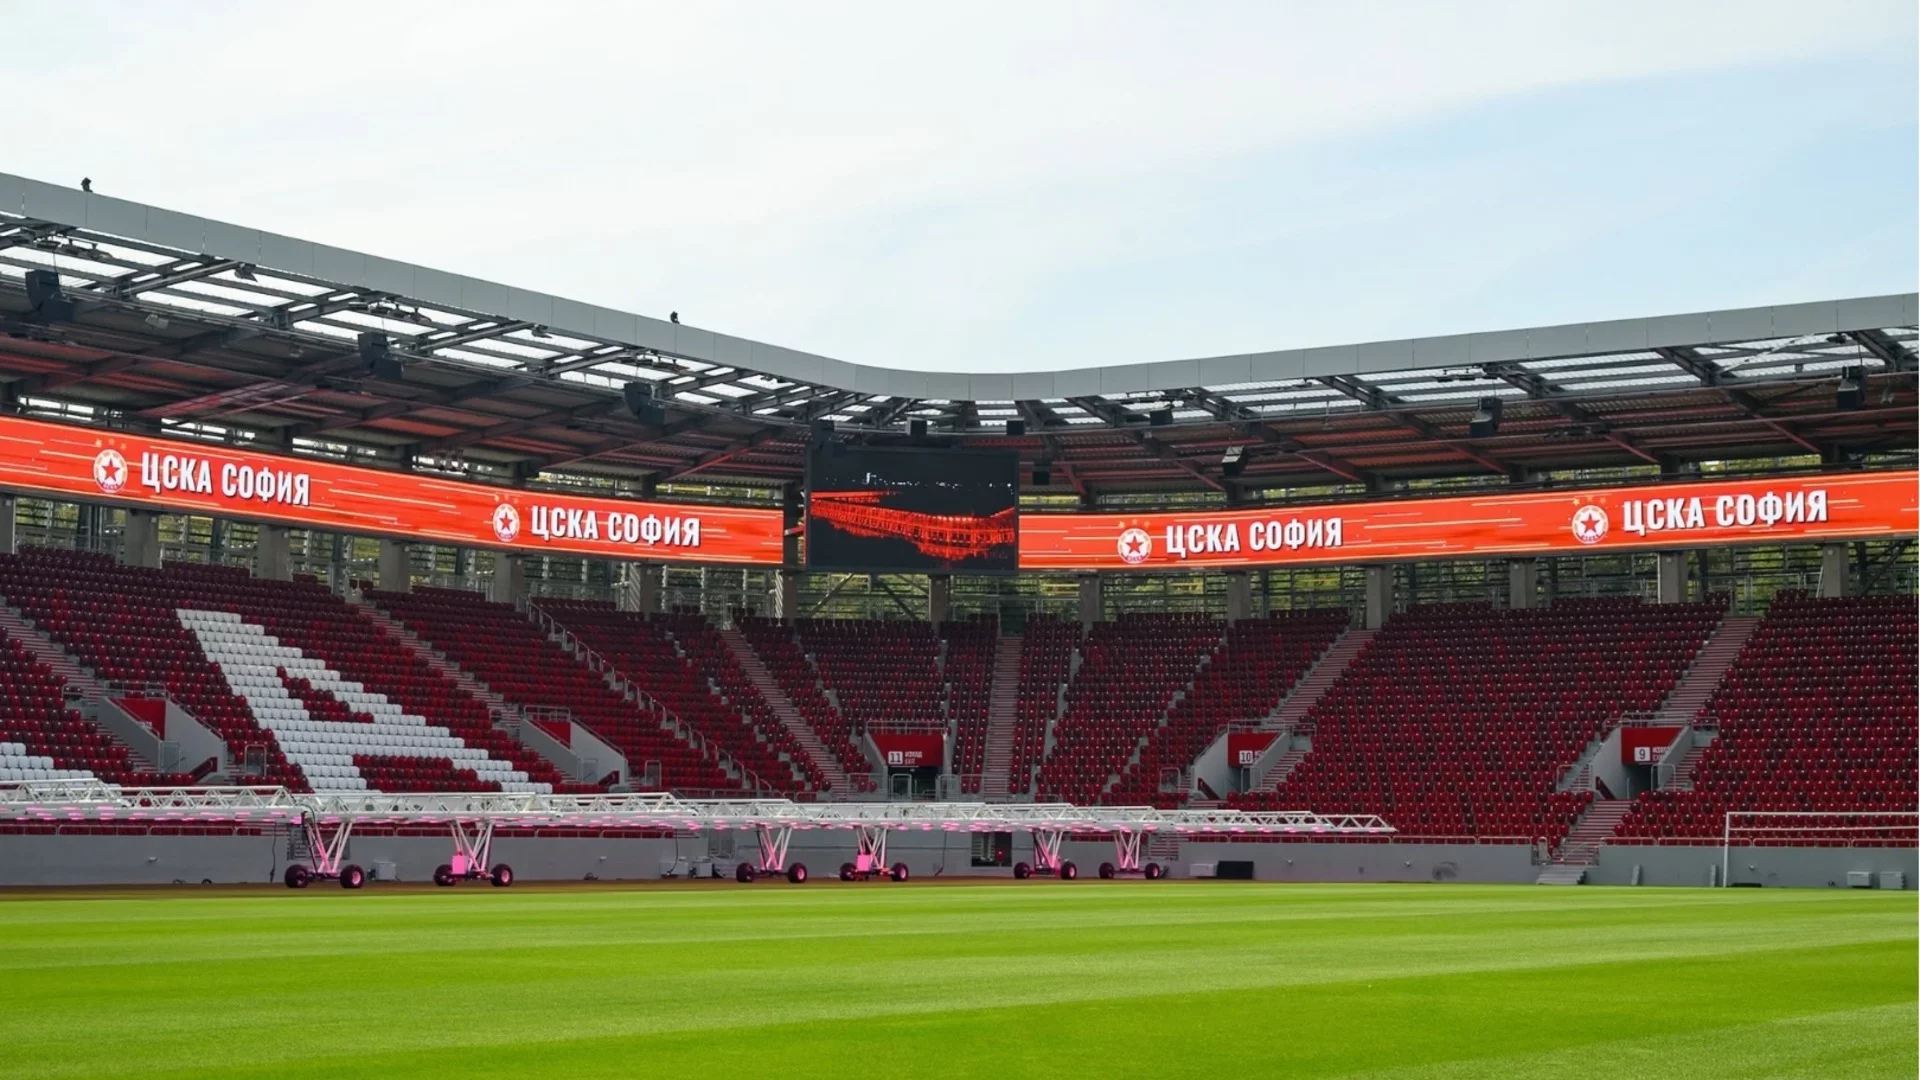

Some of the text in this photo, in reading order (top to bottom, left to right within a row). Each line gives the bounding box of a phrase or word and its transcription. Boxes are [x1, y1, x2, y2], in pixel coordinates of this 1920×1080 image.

[141, 453, 310, 507] ЦСКА СОФИЯ
[531, 506, 701, 546] ЦСКА СОФИЯ
[1624, 491, 1828, 536] ЦСКА СОФИЯ
[1165, 518, 1342, 558] ЦСКА СОФИЯ
[891, 753, 900, 763] 11
[1241, 752, 1251, 762] 10
[1639, 749, 1646, 760] 9
